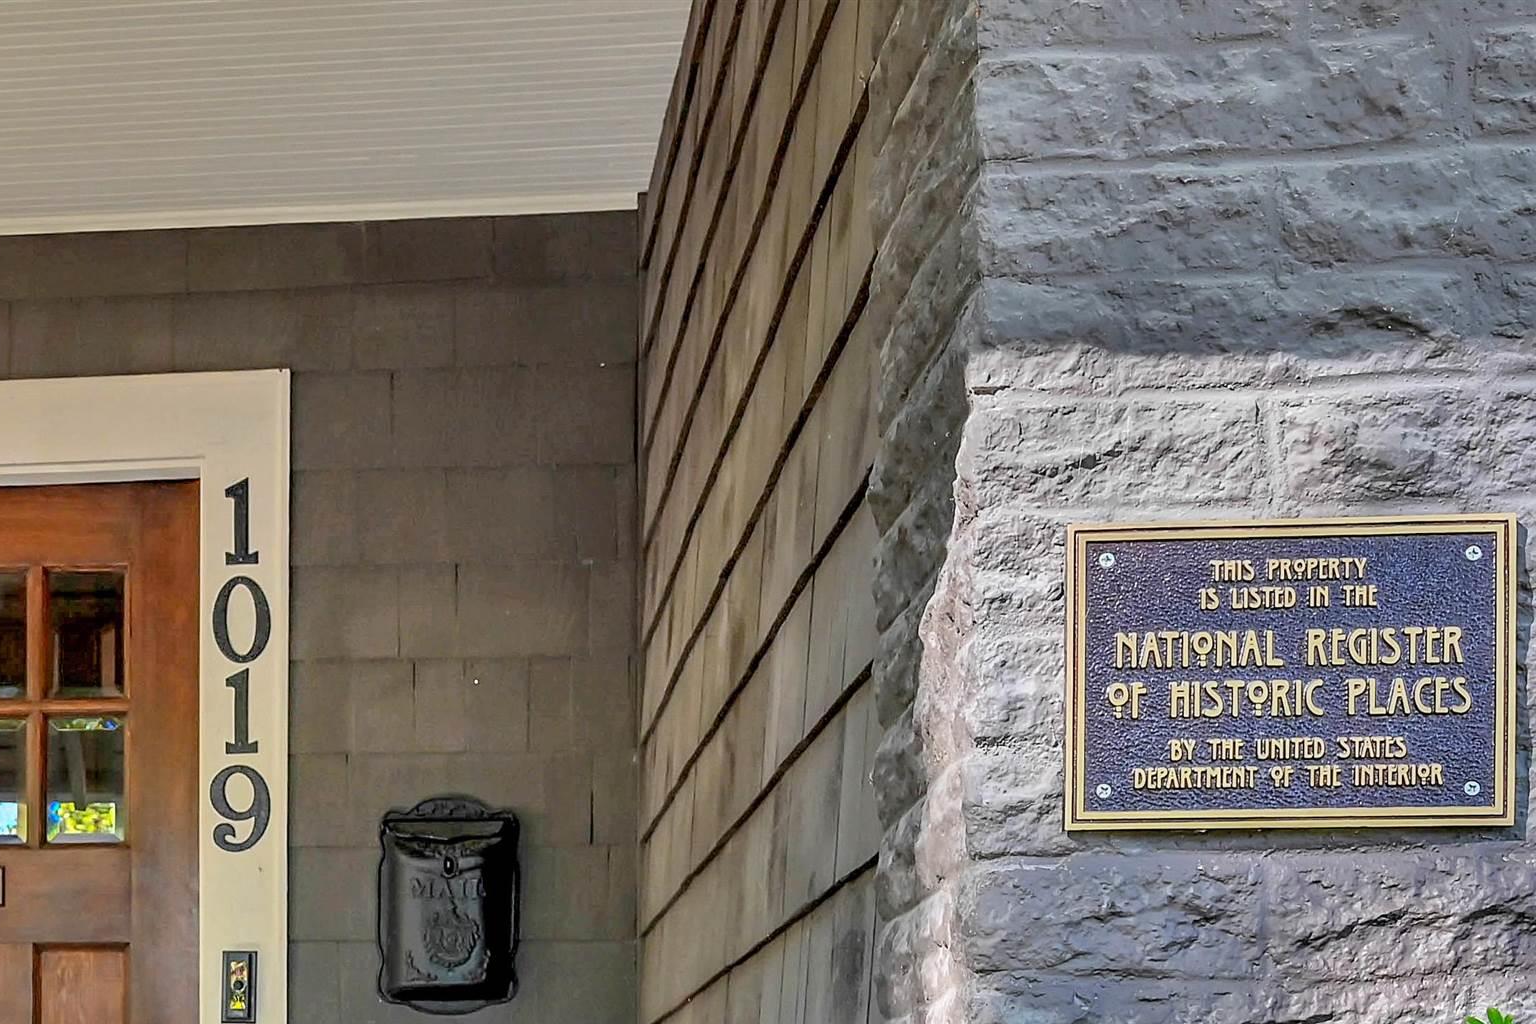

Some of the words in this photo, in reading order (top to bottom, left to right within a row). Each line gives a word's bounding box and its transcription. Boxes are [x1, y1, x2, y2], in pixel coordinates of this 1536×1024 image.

[1211, 560, 1255, 581] THIS
[1268, 558, 1366, 580] PROPERTY
[1199, 588, 1220, 610] IS
[1231, 586, 1295, 609] LISTED
[1309, 586, 1329, 608] IN
[1343, 585, 1377, 606] THE
[1115, 630, 1284, 668] NATIONAL
[1306, 627, 1463, 666] REGISTER
[210, 477, 272, 853] 1019
[1107, 681, 1147, 719] OF
[1169, 679, 1324, 718] HISTORIC
[1347, 677, 1472, 715] PLACES
[1170, 739, 1196, 761] BY
[1209, 738, 1243, 760] THE
[1256, 737, 1325, 759] UNITED
[1337, 736, 1407, 758] STATES
[1133, 766, 1257, 790] DEPARTMENT
[1270, 766, 1295, 788] OF
[1307, 765, 1341, 787] THE
[1353, 764, 1444, 786] INTERIOR
